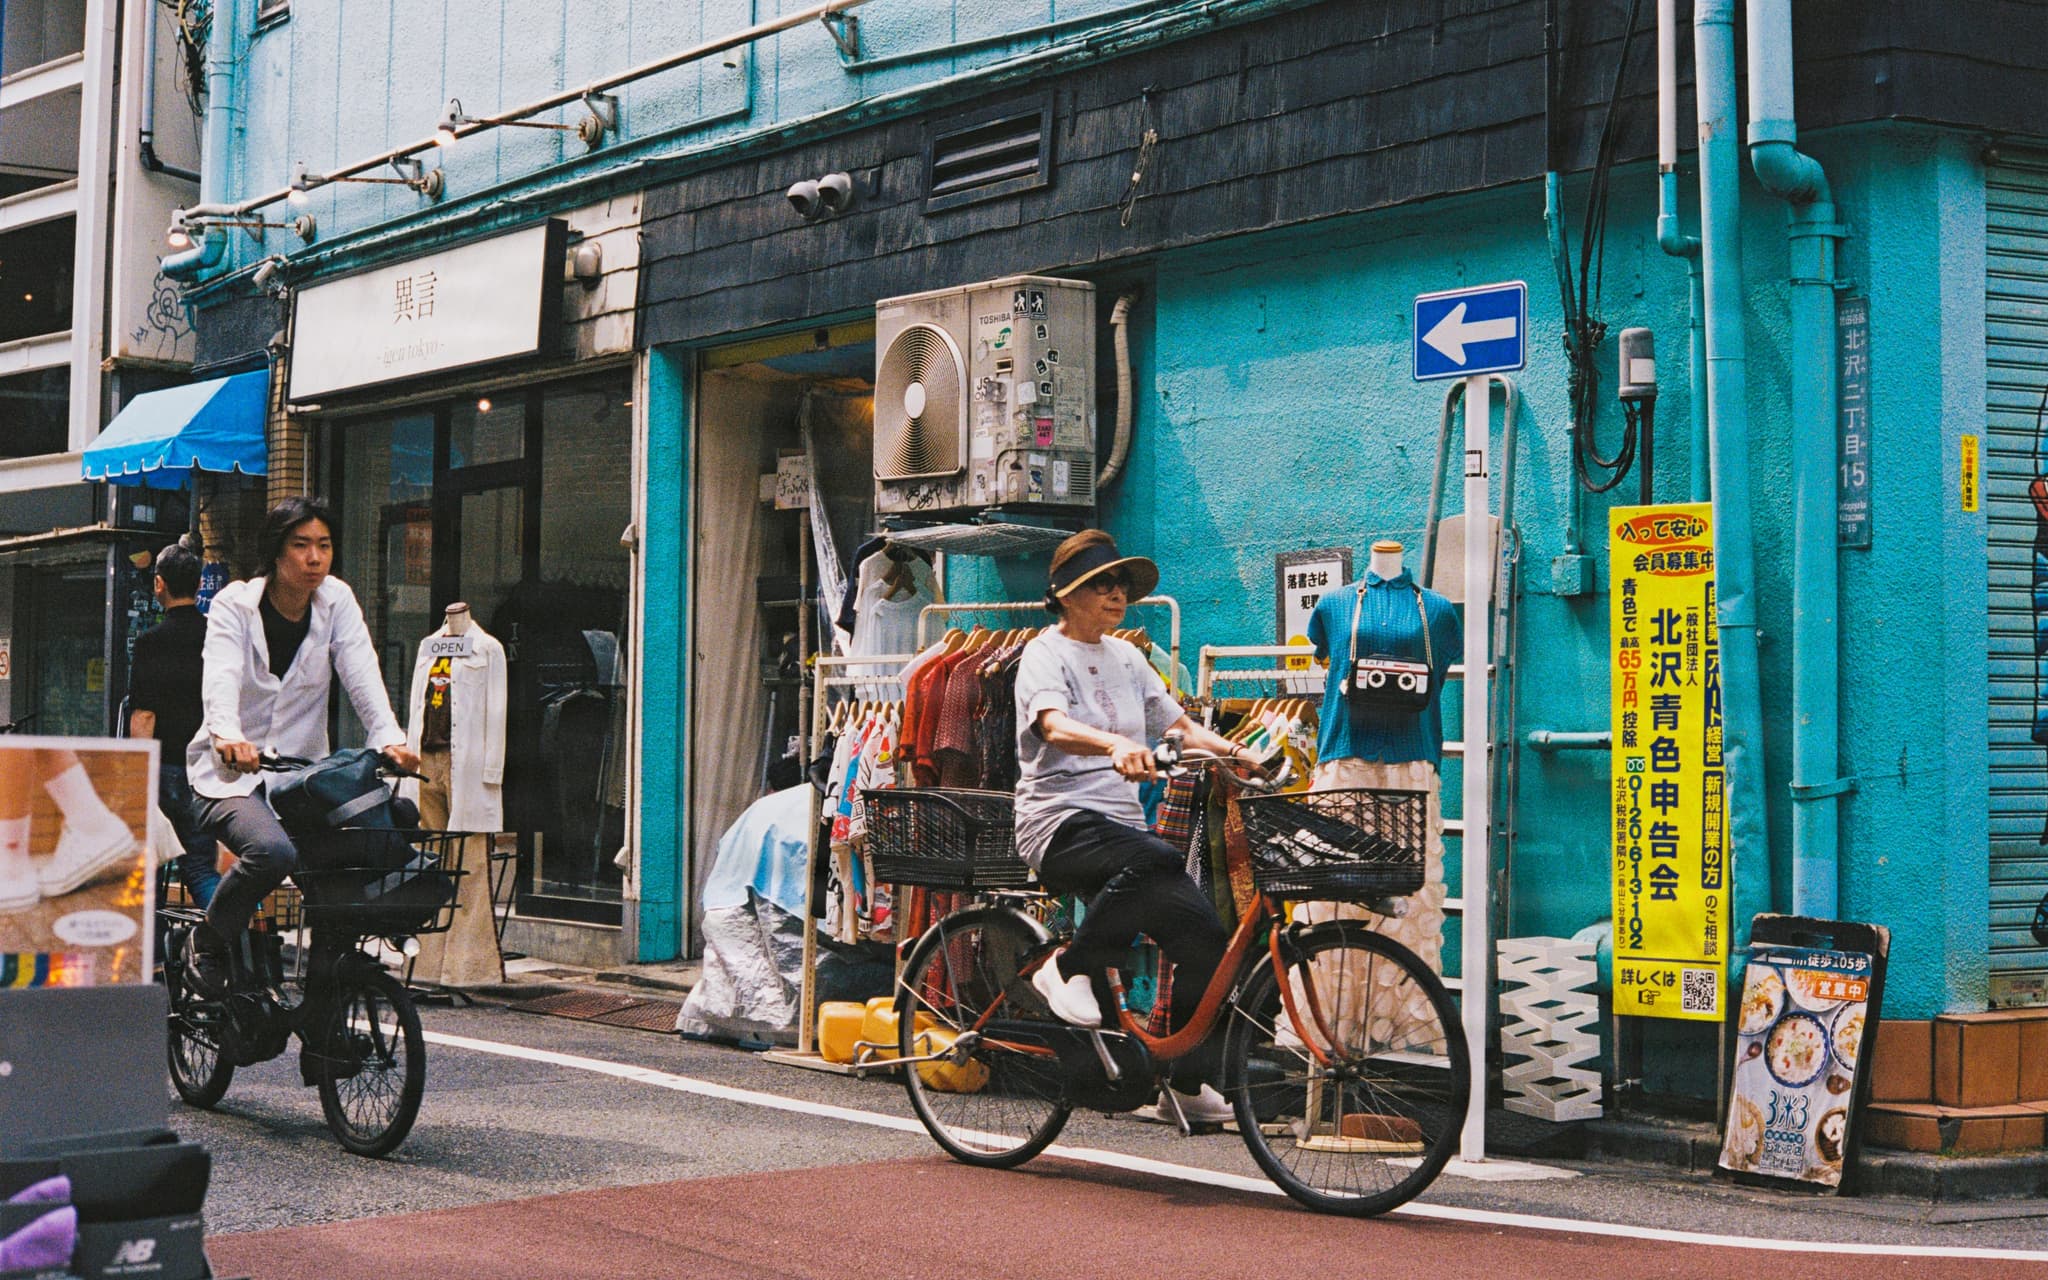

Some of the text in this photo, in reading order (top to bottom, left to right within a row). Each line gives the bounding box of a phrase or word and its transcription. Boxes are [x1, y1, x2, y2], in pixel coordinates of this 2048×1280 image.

[393, 271, 437, 325] 異言
[980, 313, 1011, 324] TOSHIBA
[1844, 329, 1860, 455] 北沢二丁目
[1841, 461, 1865, 488] 15
[1621, 518, 1703, 540] 入って安心
[1633, 550, 1713, 572] 会員募集中
[1288, 571, 1328, 589] 落書きは
[431, 642, 464, 653] OPEN
[1686, 606, 1698, 687] 一般社団法人
[1649, 608, 1682, 901] 北沢青色申告会
[1704, 775, 1722, 885] 新規開業の方
[1704, 895, 1717, 956] のご相談
[1620, 968, 1676, 987] 詳しくは
[1819, 980, 1862, 999] 営業中
